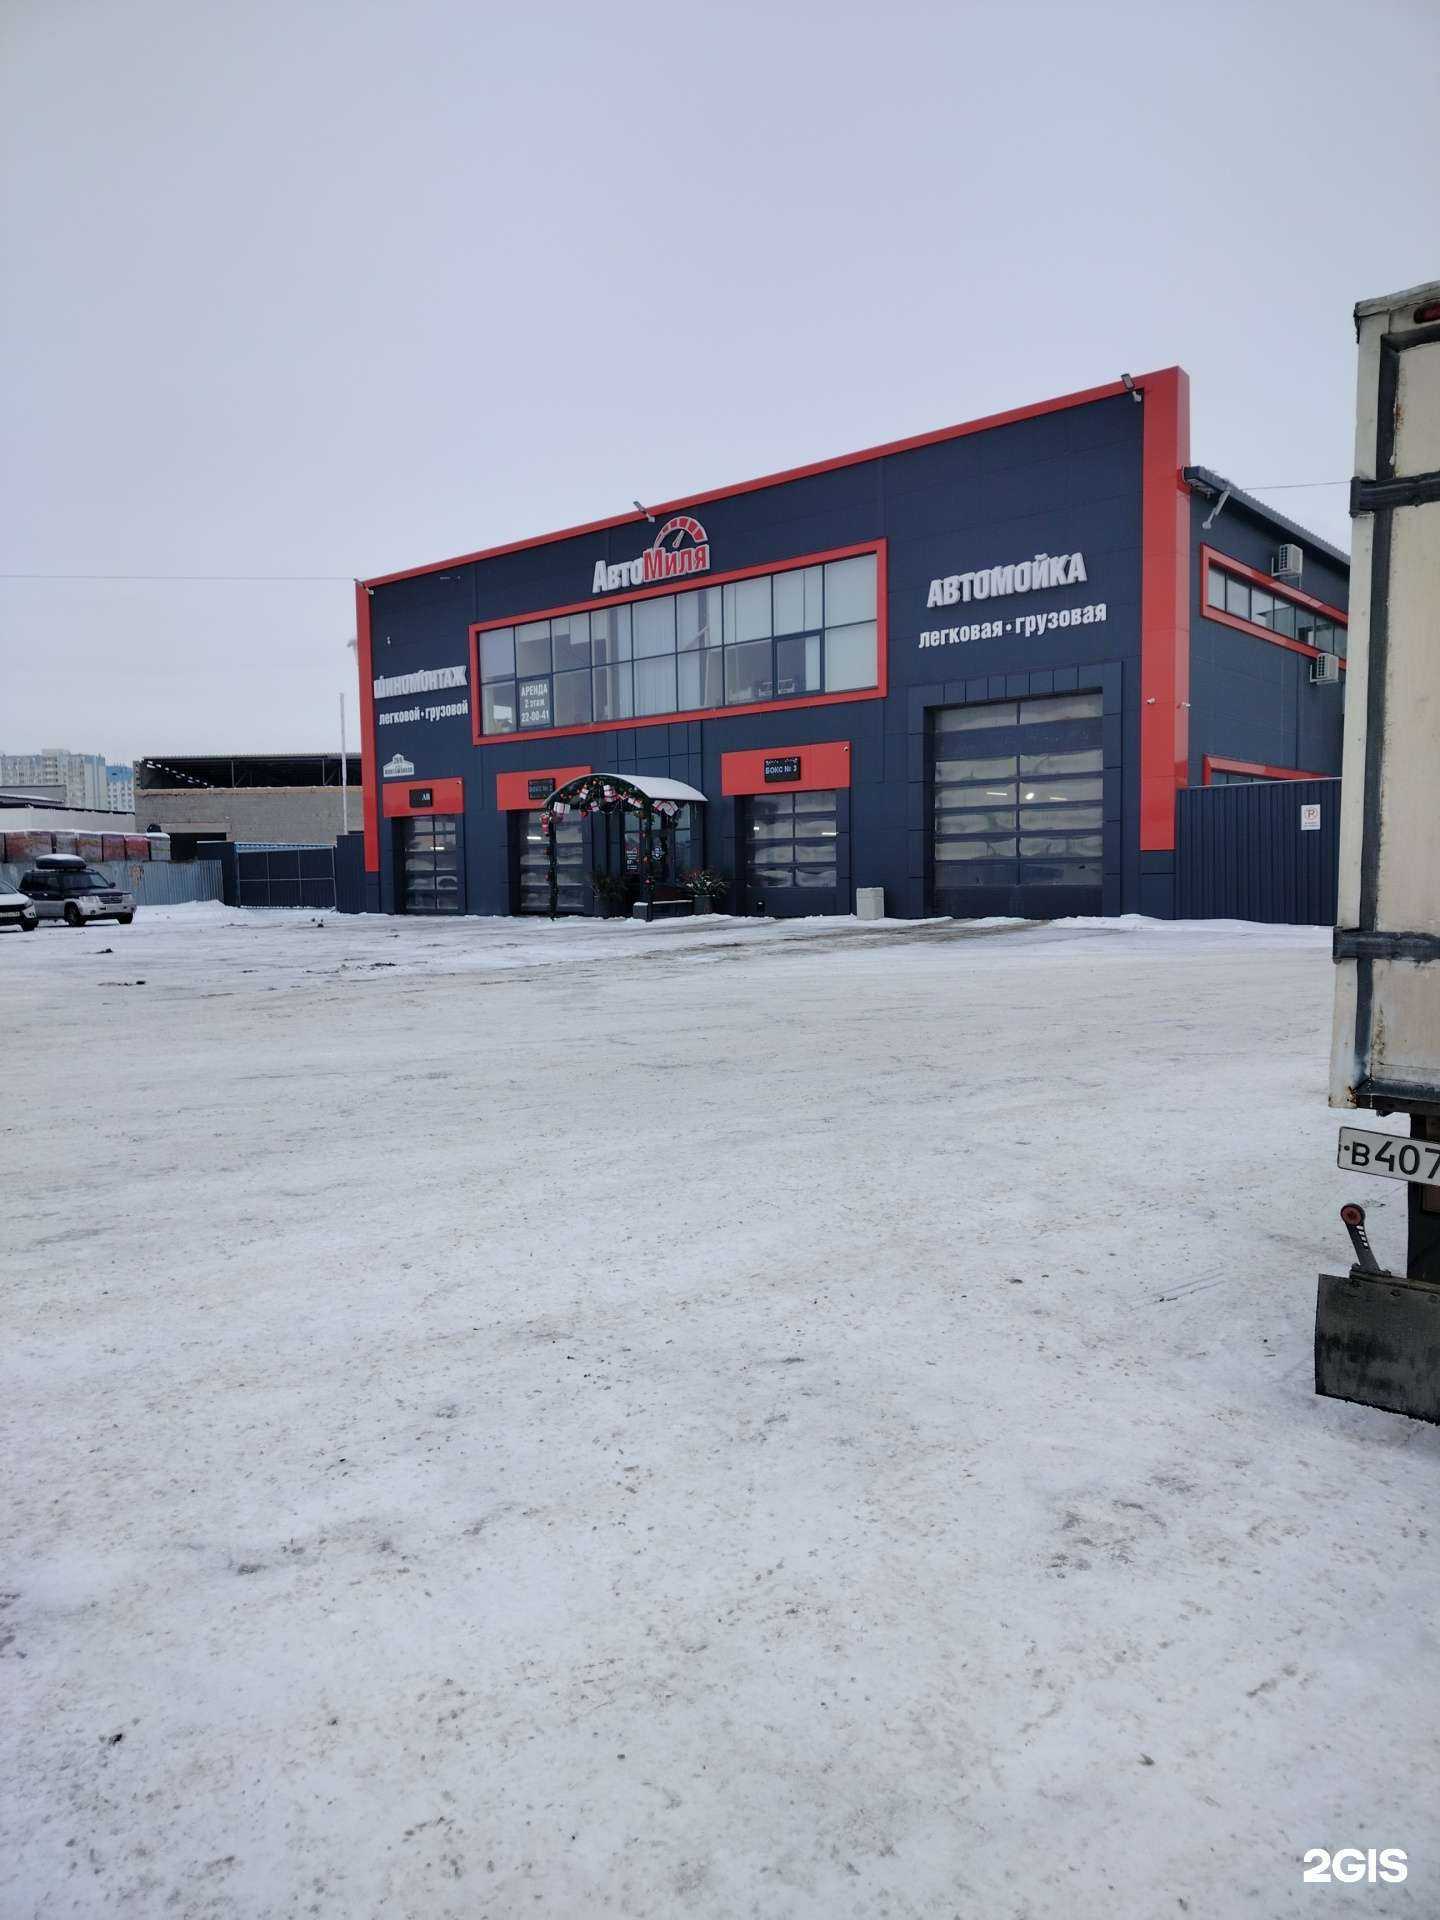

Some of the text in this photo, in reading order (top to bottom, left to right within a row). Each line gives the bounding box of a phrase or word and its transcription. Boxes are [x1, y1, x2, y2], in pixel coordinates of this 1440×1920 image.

[926, 552, 1088, 608] АВТОМОЙКА
[918, 603, 1107, 649] легковая грузовая
[373, 664, 468, 699] ШИНОМОНТАЖ
[521, 683, 548, 697] АРЕНДА
[379, 699, 469, 725] легковой грузовой
